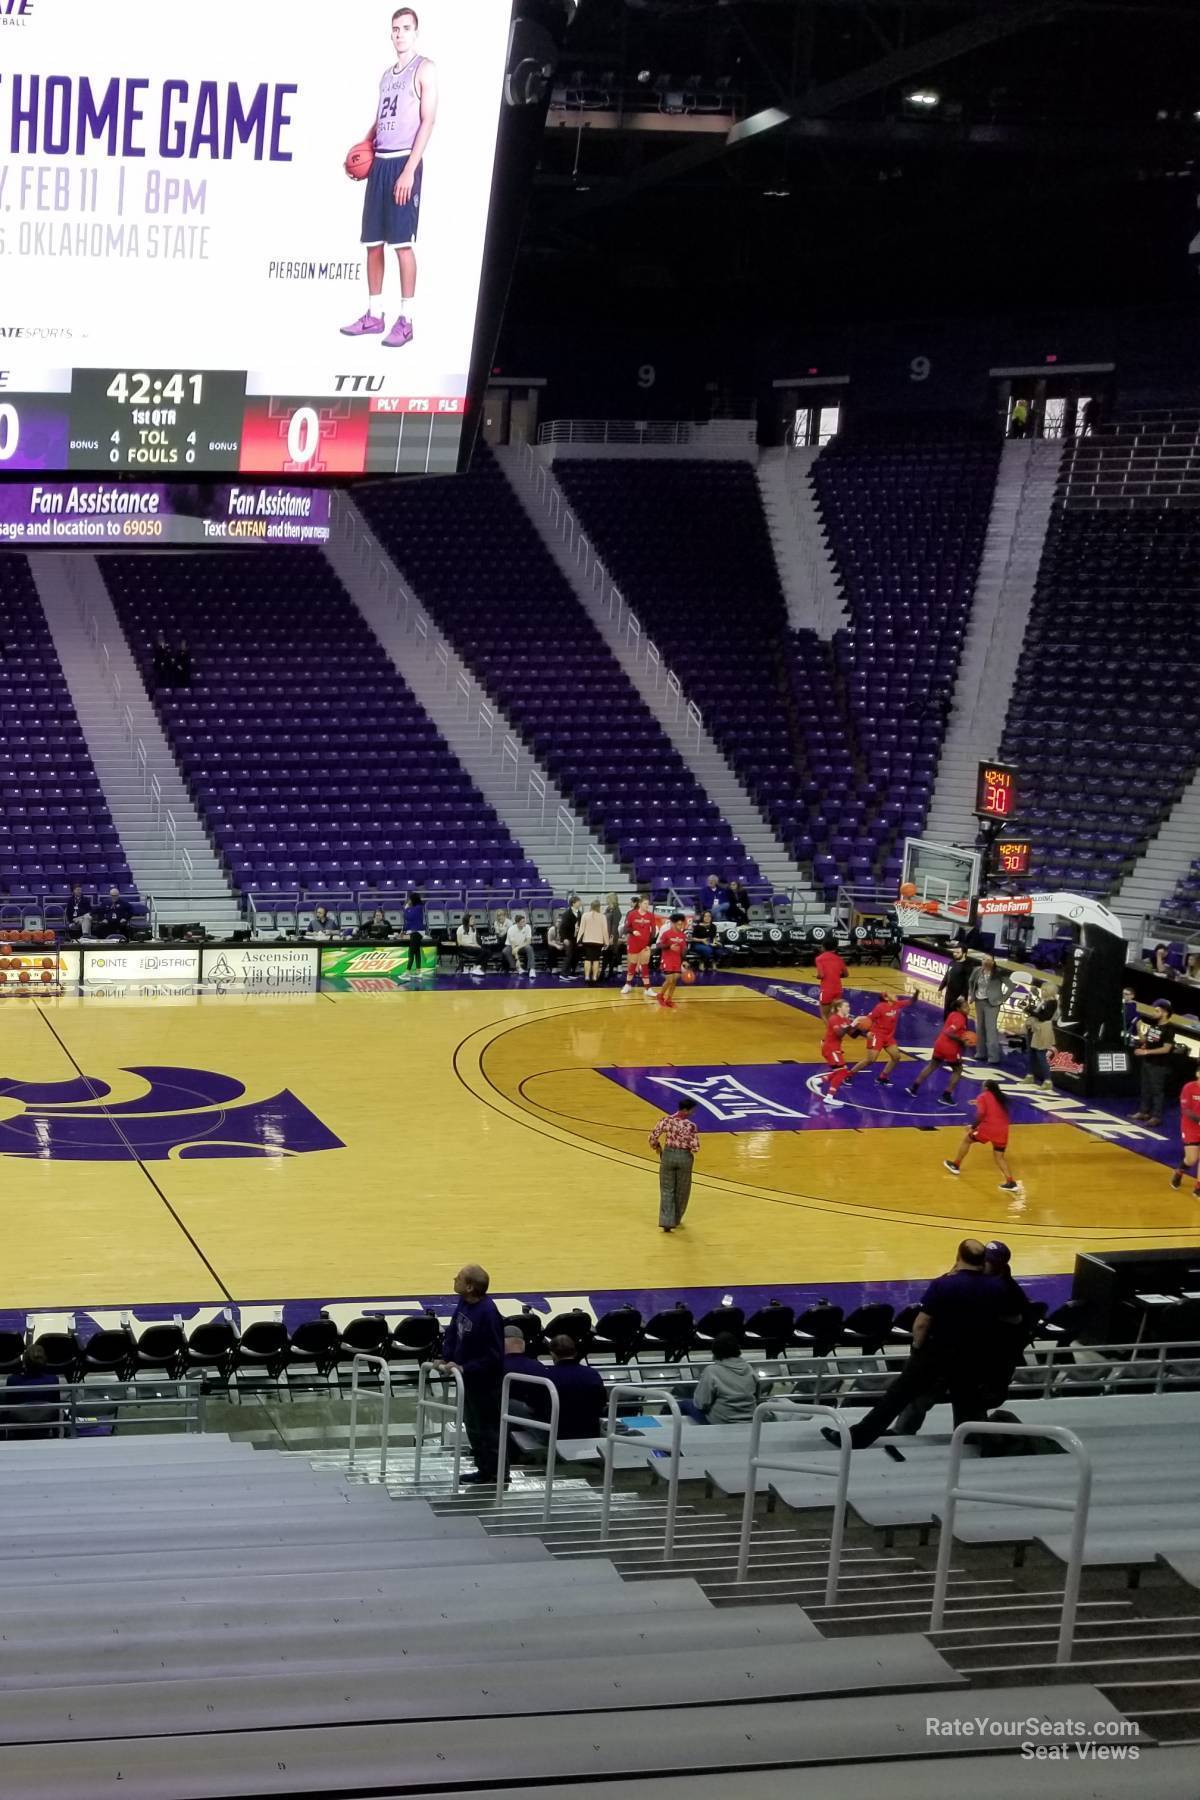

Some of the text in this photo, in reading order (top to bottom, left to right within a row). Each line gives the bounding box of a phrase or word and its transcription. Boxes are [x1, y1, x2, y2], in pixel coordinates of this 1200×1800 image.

[380, 94, 398, 119] 24
[11, 74, 150, 158] HOME
[158, 79, 298, 162] GAME
[20, 166, 70, 210] FEB
[80, 167, 98, 211] 11
[145, 170, 207, 215] 8PM
[19, 222, 139, 259] OKLAHOMA
[146, 225, 211, 260] STATE
[269, 261, 315, 279] PIERSON
[106, 372, 203, 404] 42:41
[334, 375, 385, 392] TTU
[377, 398, 459, 411] PLY PTS FLS
[131, 408, 176, 426] 1st QTR
[110, 430, 197, 445] 4 TOL 4
[287, 407, 320, 463] 0
[70, 440, 99, 449] BONUS
[208, 441, 238, 451] BONUS
[109, 449, 196, 463] 0 FOULS 0
[31, 485, 160, 515] Fan Assistance
[228, 488, 311, 517] Fan Assistance
[26, 519, 51, 536] and
[53, 519, 104, 536] location
[107, 521, 121, 536] to
[123, 520, 162, 536] 69050
[202, 520, 227, 537] Text
[228, 520, 267, 537] CATFAN
[267, 521, 284, 538] and
[284, 522, 300, 539] then
[300, 525, 314, 542] your
[984, 769, 1011, 787] 42:41
[987, 786, 1006, 813] 30
[999, 843, 1027, 855] 42:41
[1004, 856, 1019, 870] 30
[91, 958, 128, 968] POINTE
[242, 951, 309, 962] Ascension
[905, 951, 949, 977] AHEARN
[243, 965, 312, 977] Via Christi
[1067, 959, 1082, 1017] WILDCATS
